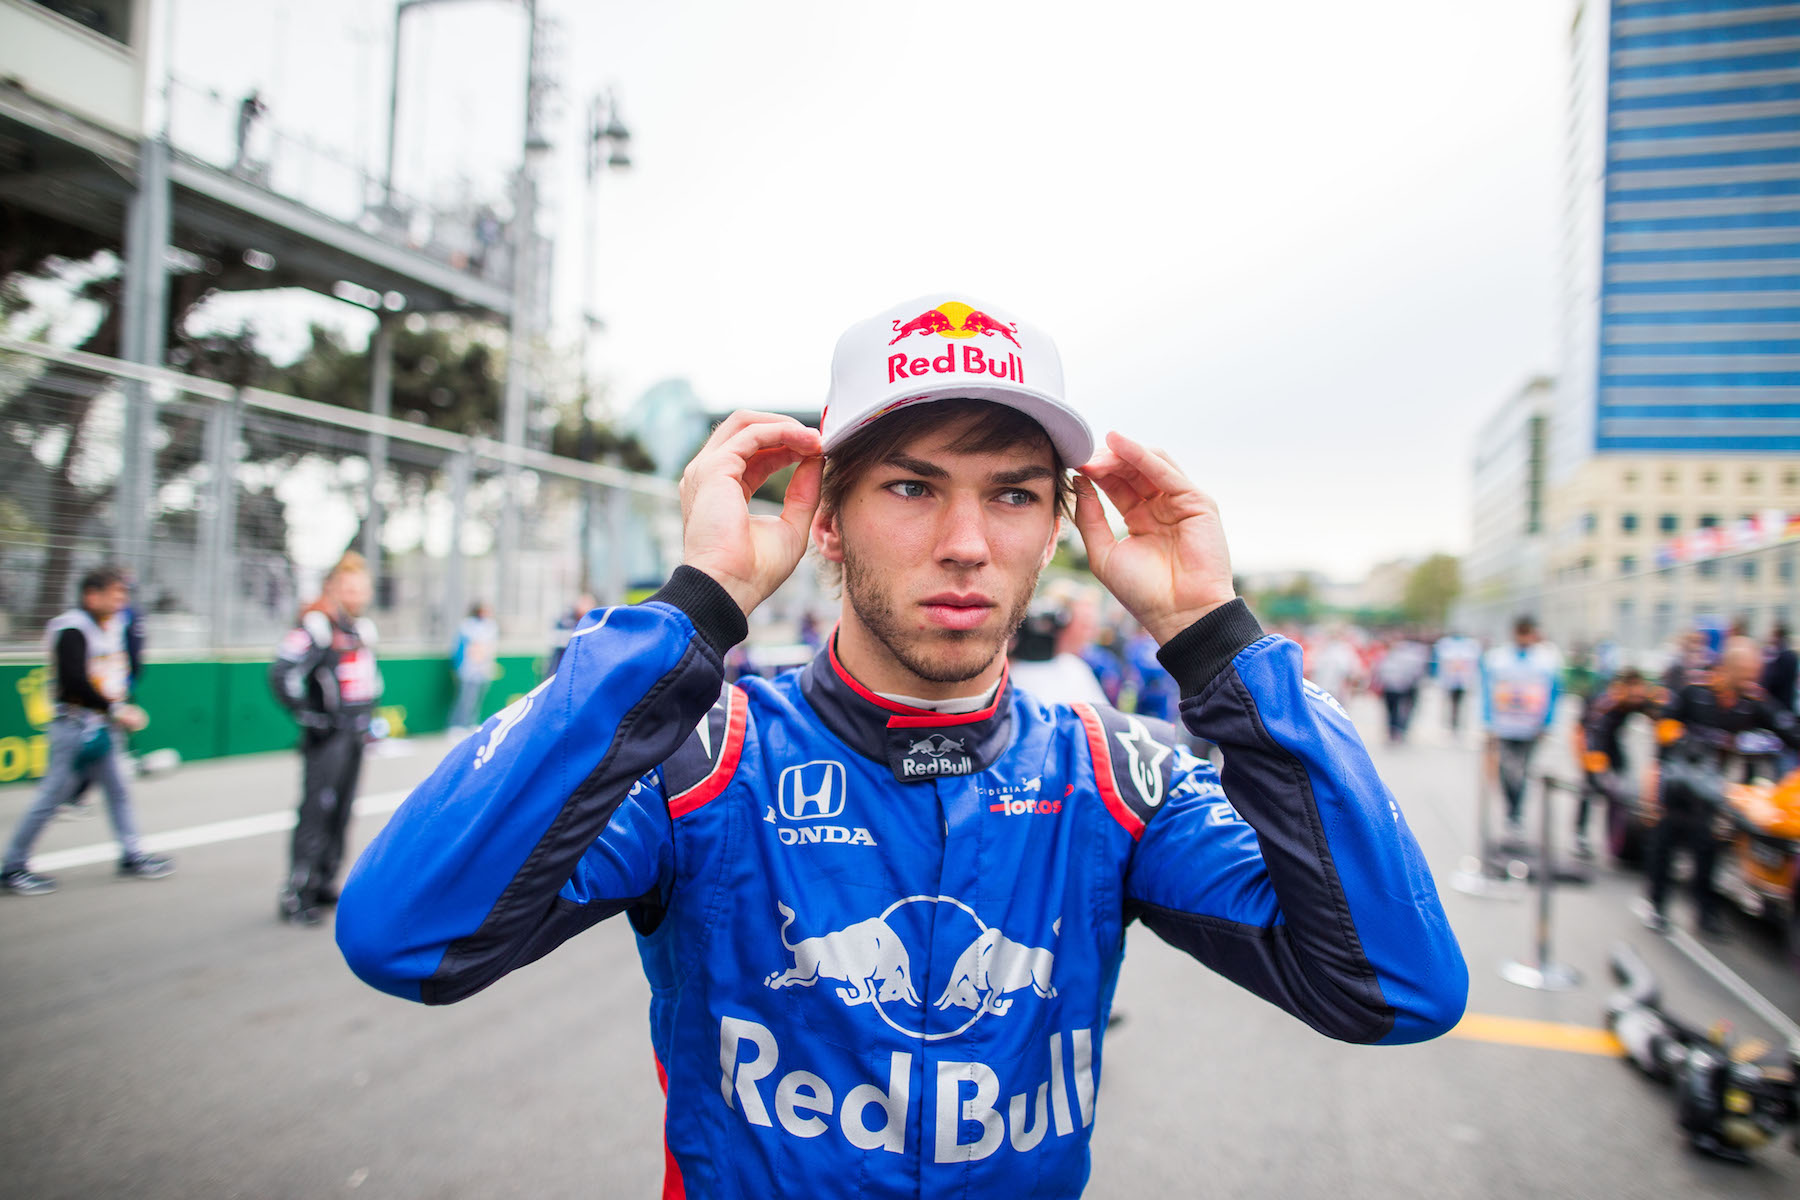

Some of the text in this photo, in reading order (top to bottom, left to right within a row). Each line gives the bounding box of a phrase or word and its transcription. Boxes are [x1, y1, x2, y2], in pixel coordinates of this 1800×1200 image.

[888, 343, 1024, 384] Red Bull
[902, 756, 972, 776] Red Bull
[720, 1015, 1095, 1164] Red Bull
